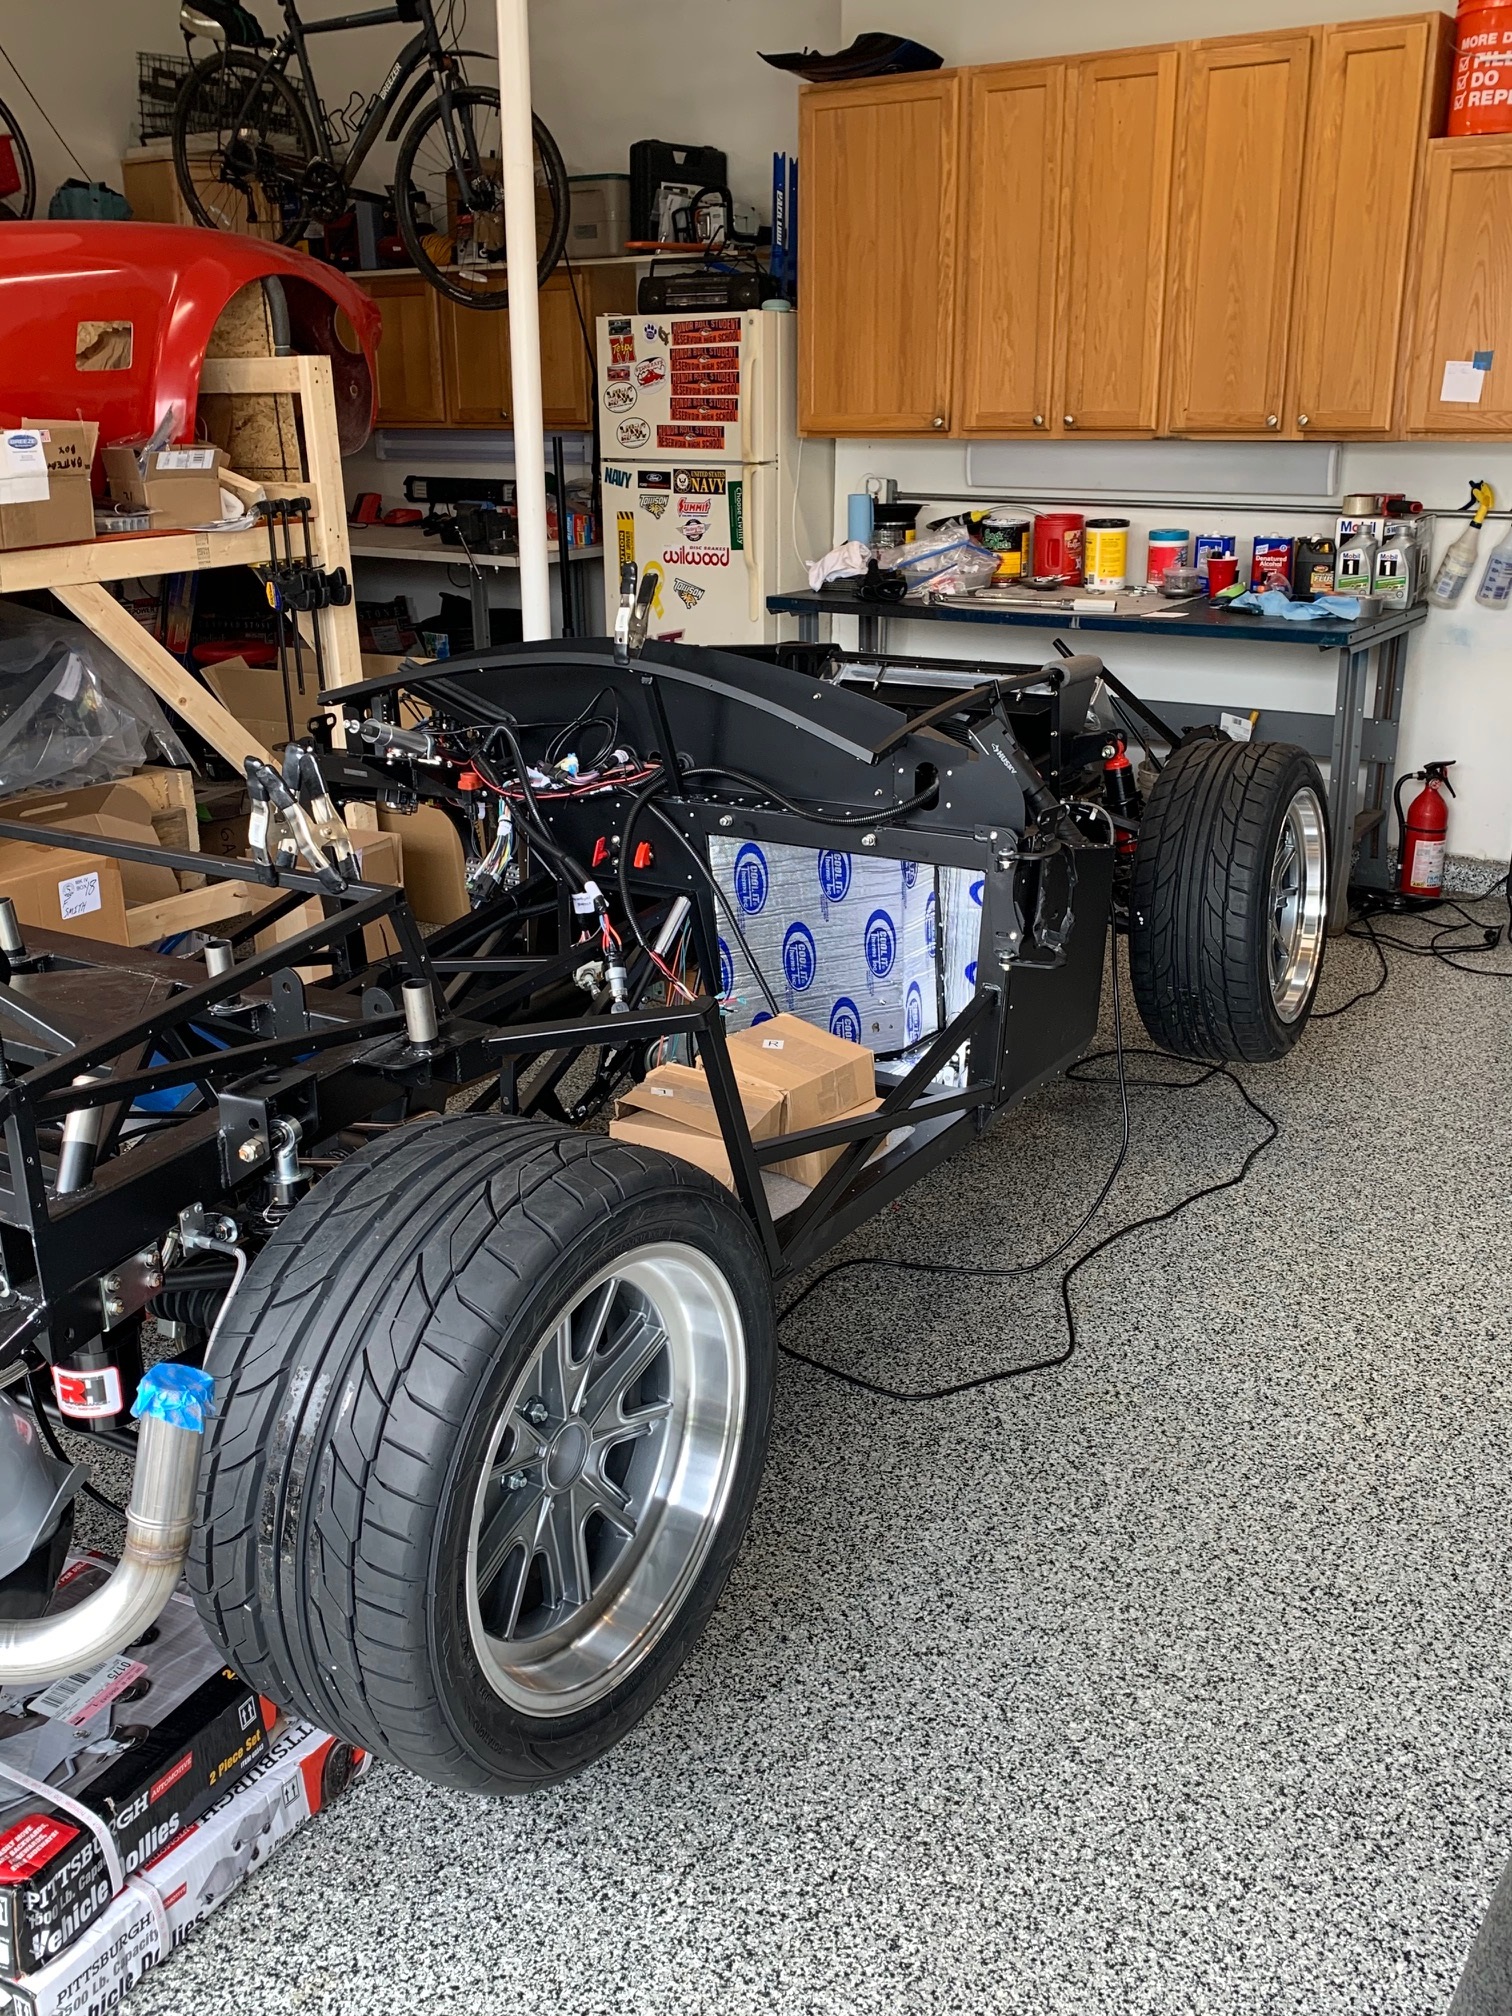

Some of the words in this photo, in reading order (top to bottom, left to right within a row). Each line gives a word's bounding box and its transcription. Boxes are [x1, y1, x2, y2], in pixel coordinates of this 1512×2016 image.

[1461, 32, 1498, 50] MORE
[379, 62, 402, 100] BREEZER
[1471, 70, 1499, 88] DO
[1467, 90, 1512, 107] REP
[673, 322, 693, 332] HONOR
[695, 320, 709, 328] ROLL
[711, 318, 738, 329] STUDENT
[673, 334, 701, 345] RESERVOIR
[718, 330, 740, 342] SCHOOL
[672, 349, 692, 359] HONOR
[693, 348, 708, 356] ROLL
[709, 347, 736, 357] STUDENT
[671, 360, 700, 371] RESERVOIR
[717, 359, 737, 371] SCHOOL
[673, 373, 692, 383] HONOR
[694, 373, 708, 381] ROLL
[710, 372, 737, 383] STUDENT
[672, 384, 701, 395] RESERVOIR
[717, 383, 737, 395] SCHOOL
[672, 399, 692, 409] HONOR
[693, 398, 708, 406] ROLL
[709, 399, 736, 410] STUDENT
[671, 409, 700, 421] RESERVOIR
[716, 410, 736, 421] SCHOOL
[658, 425, 678, 436] HONOR
[680, 425, 693, 433] ROLL
[695, 426, 722, 438] STUDENT
[58, 444, 76, 455] BOX
[658, 436, 686, 448] RESERVOIR
[689, 440, 700, 448] HIGH
[702, 438, 722, 449] SCHOOL
[604, 466, 632, 489] NAVY
[691, 478, 725, 492] NAVY
[640, 495, 668, 507] TOWSON
[678, 497, 710, 512] SUMMIT
[1341, 521, 1376, 533] Moil
[663, 546, 730, 567] wilwood
[1347, 560, 1354, 574] 1
[1384, 561, 1391, 576] 1
[675, 580, 705, 600] TOWSON
[997, 750, 1018, 774] HUSKY
[750, 866, 758, 892] COOL
[64, 901, 87, 918] SMITH
[845, 1018, 853, 1041] COO
[107, 1661, 131, 1680] 0175
[209, 1771, 217, 1786] 2
[218, 1747, 244, 1776] Piece
[245, 1729, 261, 1751] Set
[151, 1757, 192, 1799] AUTOMOTIVE
[14, 1825, 34, 1843] MOVE
[274, 1827, 293, 1850] Piece
[121, 1812, 180, 1877] ollies
[60, 1892, 76, 1910] Lb.
[78, 1857, 107, 1890] Capa
[30, 1879, 109, 1960] Vehicle
[57, 1910, 153, 2006] PITTSBURGH
[92, 1978, 110, 1996] Lb.
[113, 1929, 159, 1977] Capacity
[88, 1972, 134, 2016] hicle
